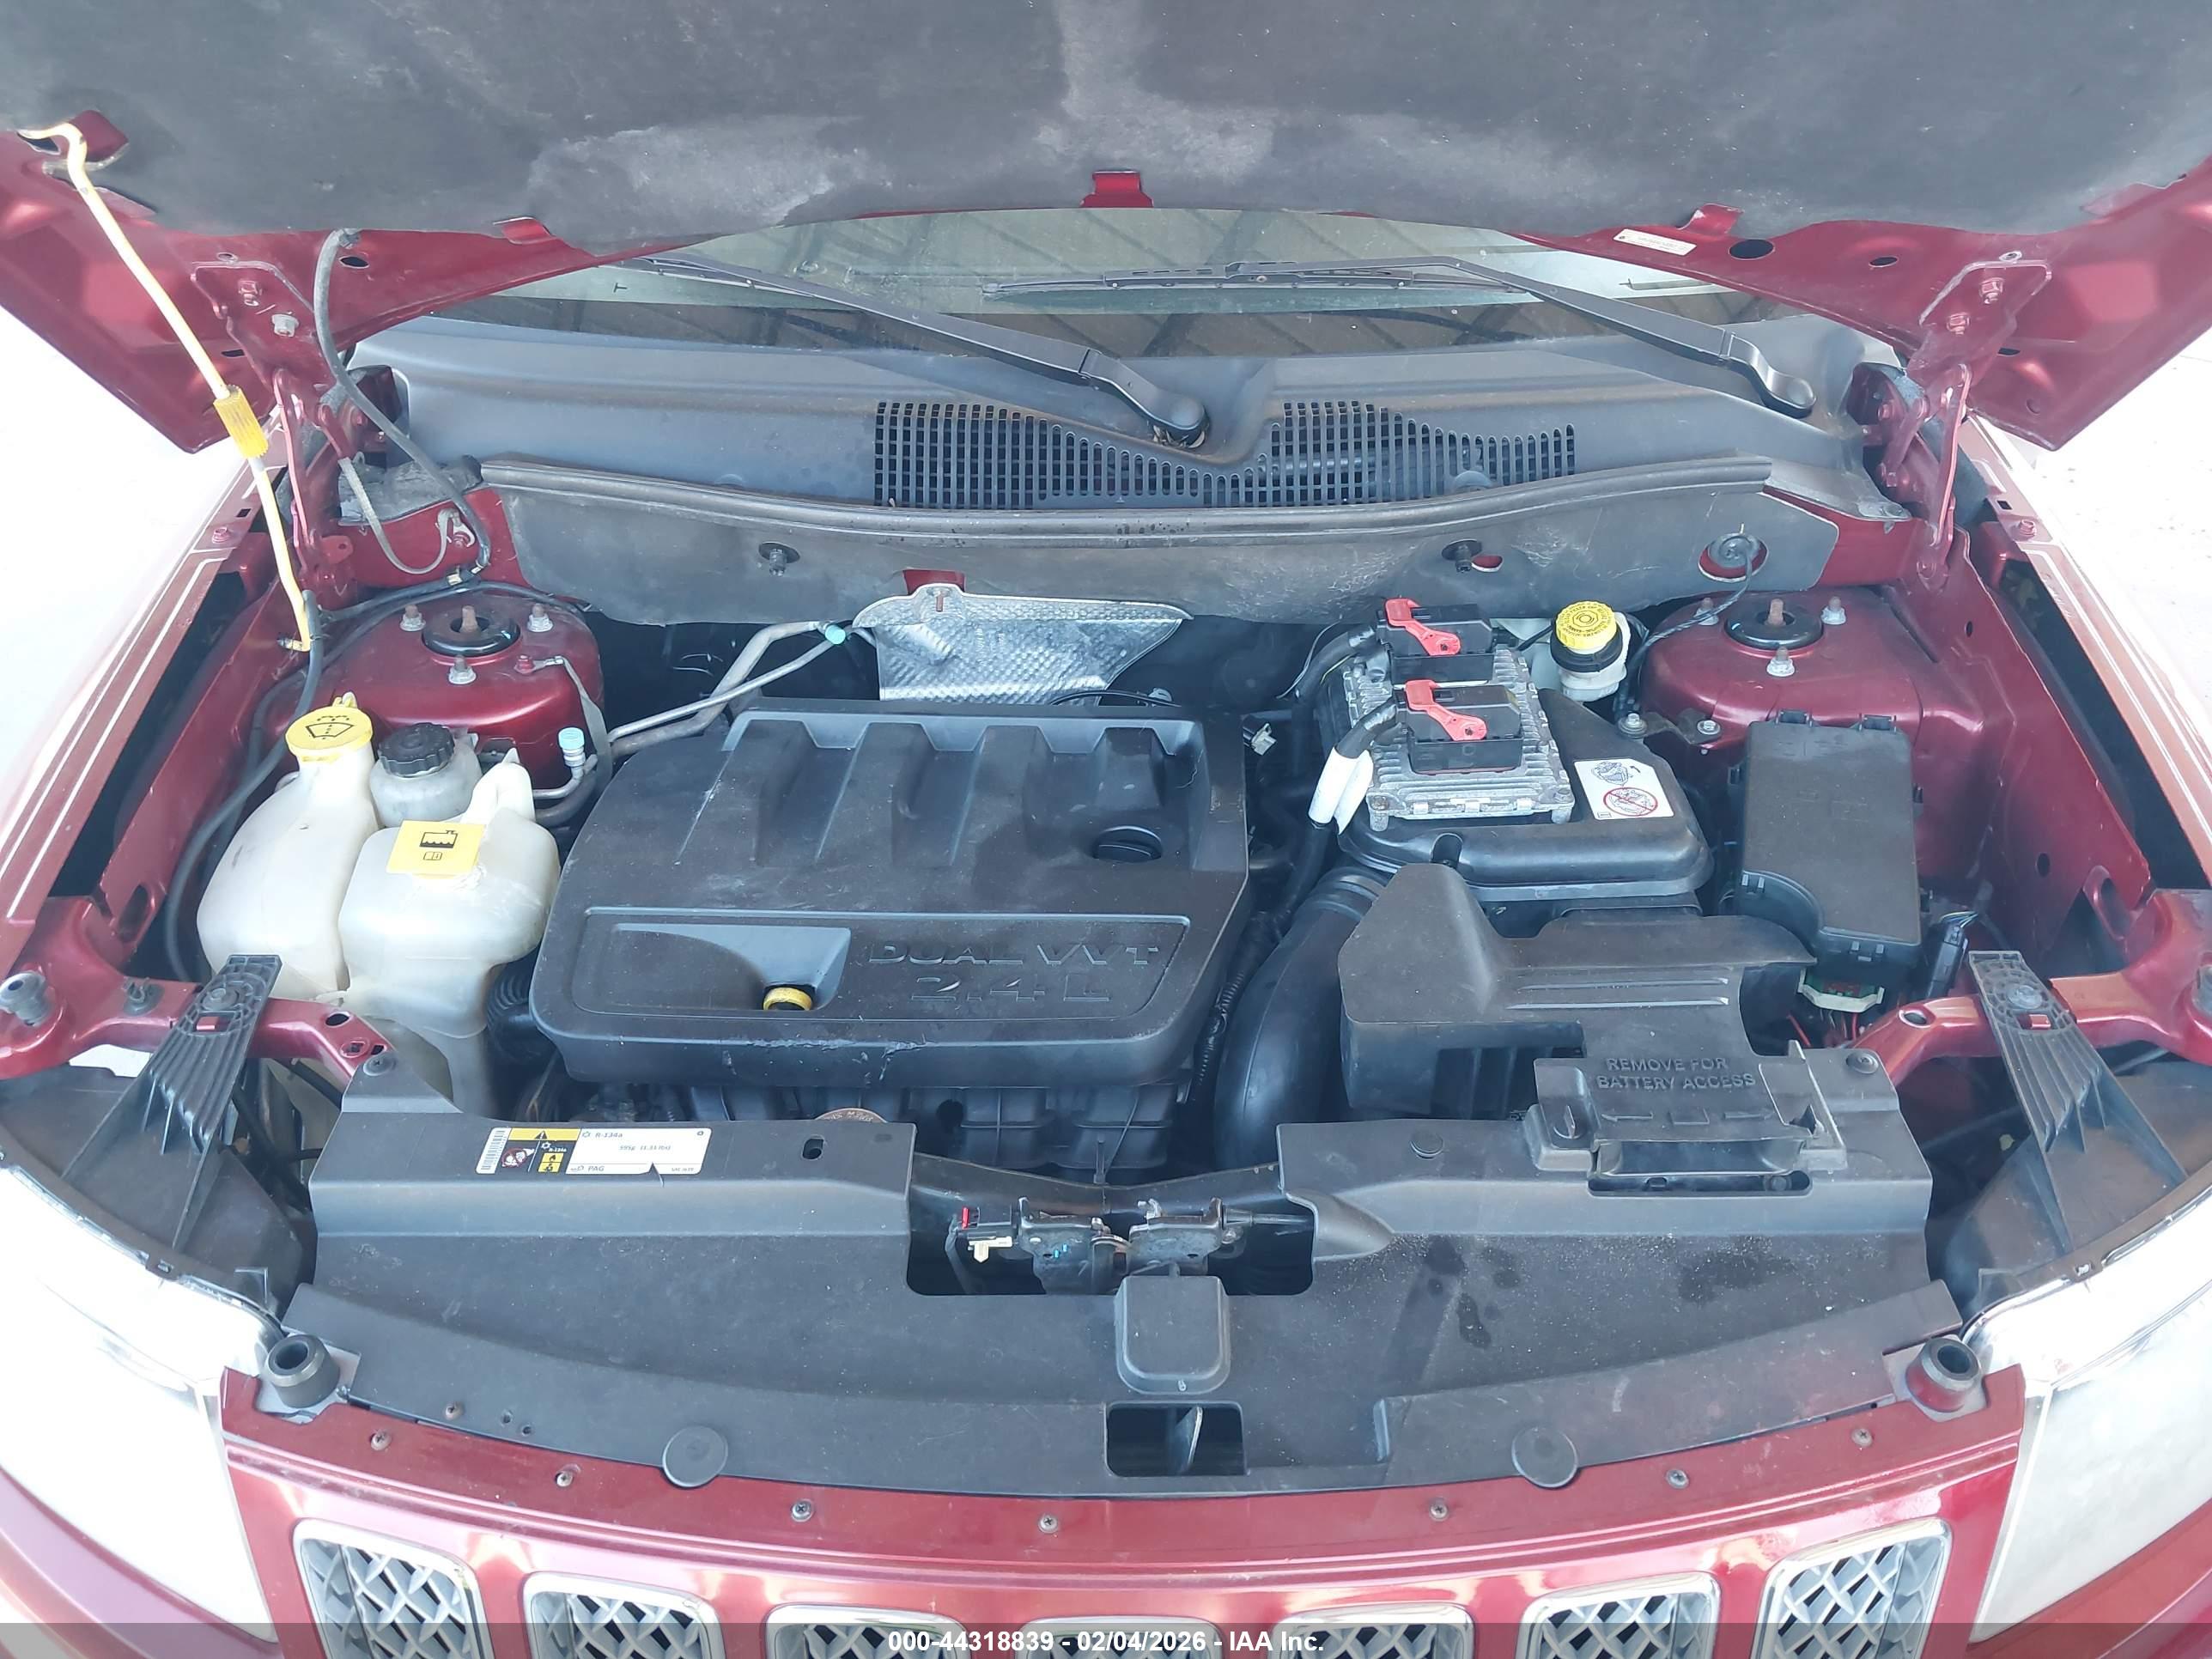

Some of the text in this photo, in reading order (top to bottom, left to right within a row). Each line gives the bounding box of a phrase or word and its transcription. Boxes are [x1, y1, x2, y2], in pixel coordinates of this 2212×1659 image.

[868, 943, 1160, 965] DUAL VVT
[910, 974, 1110, 1002] 2.4L
[1607, 1057, 1729, 1072] REMOVE FOR
[1595, 1073, 1756, 1091] BATTERY ACCESS
